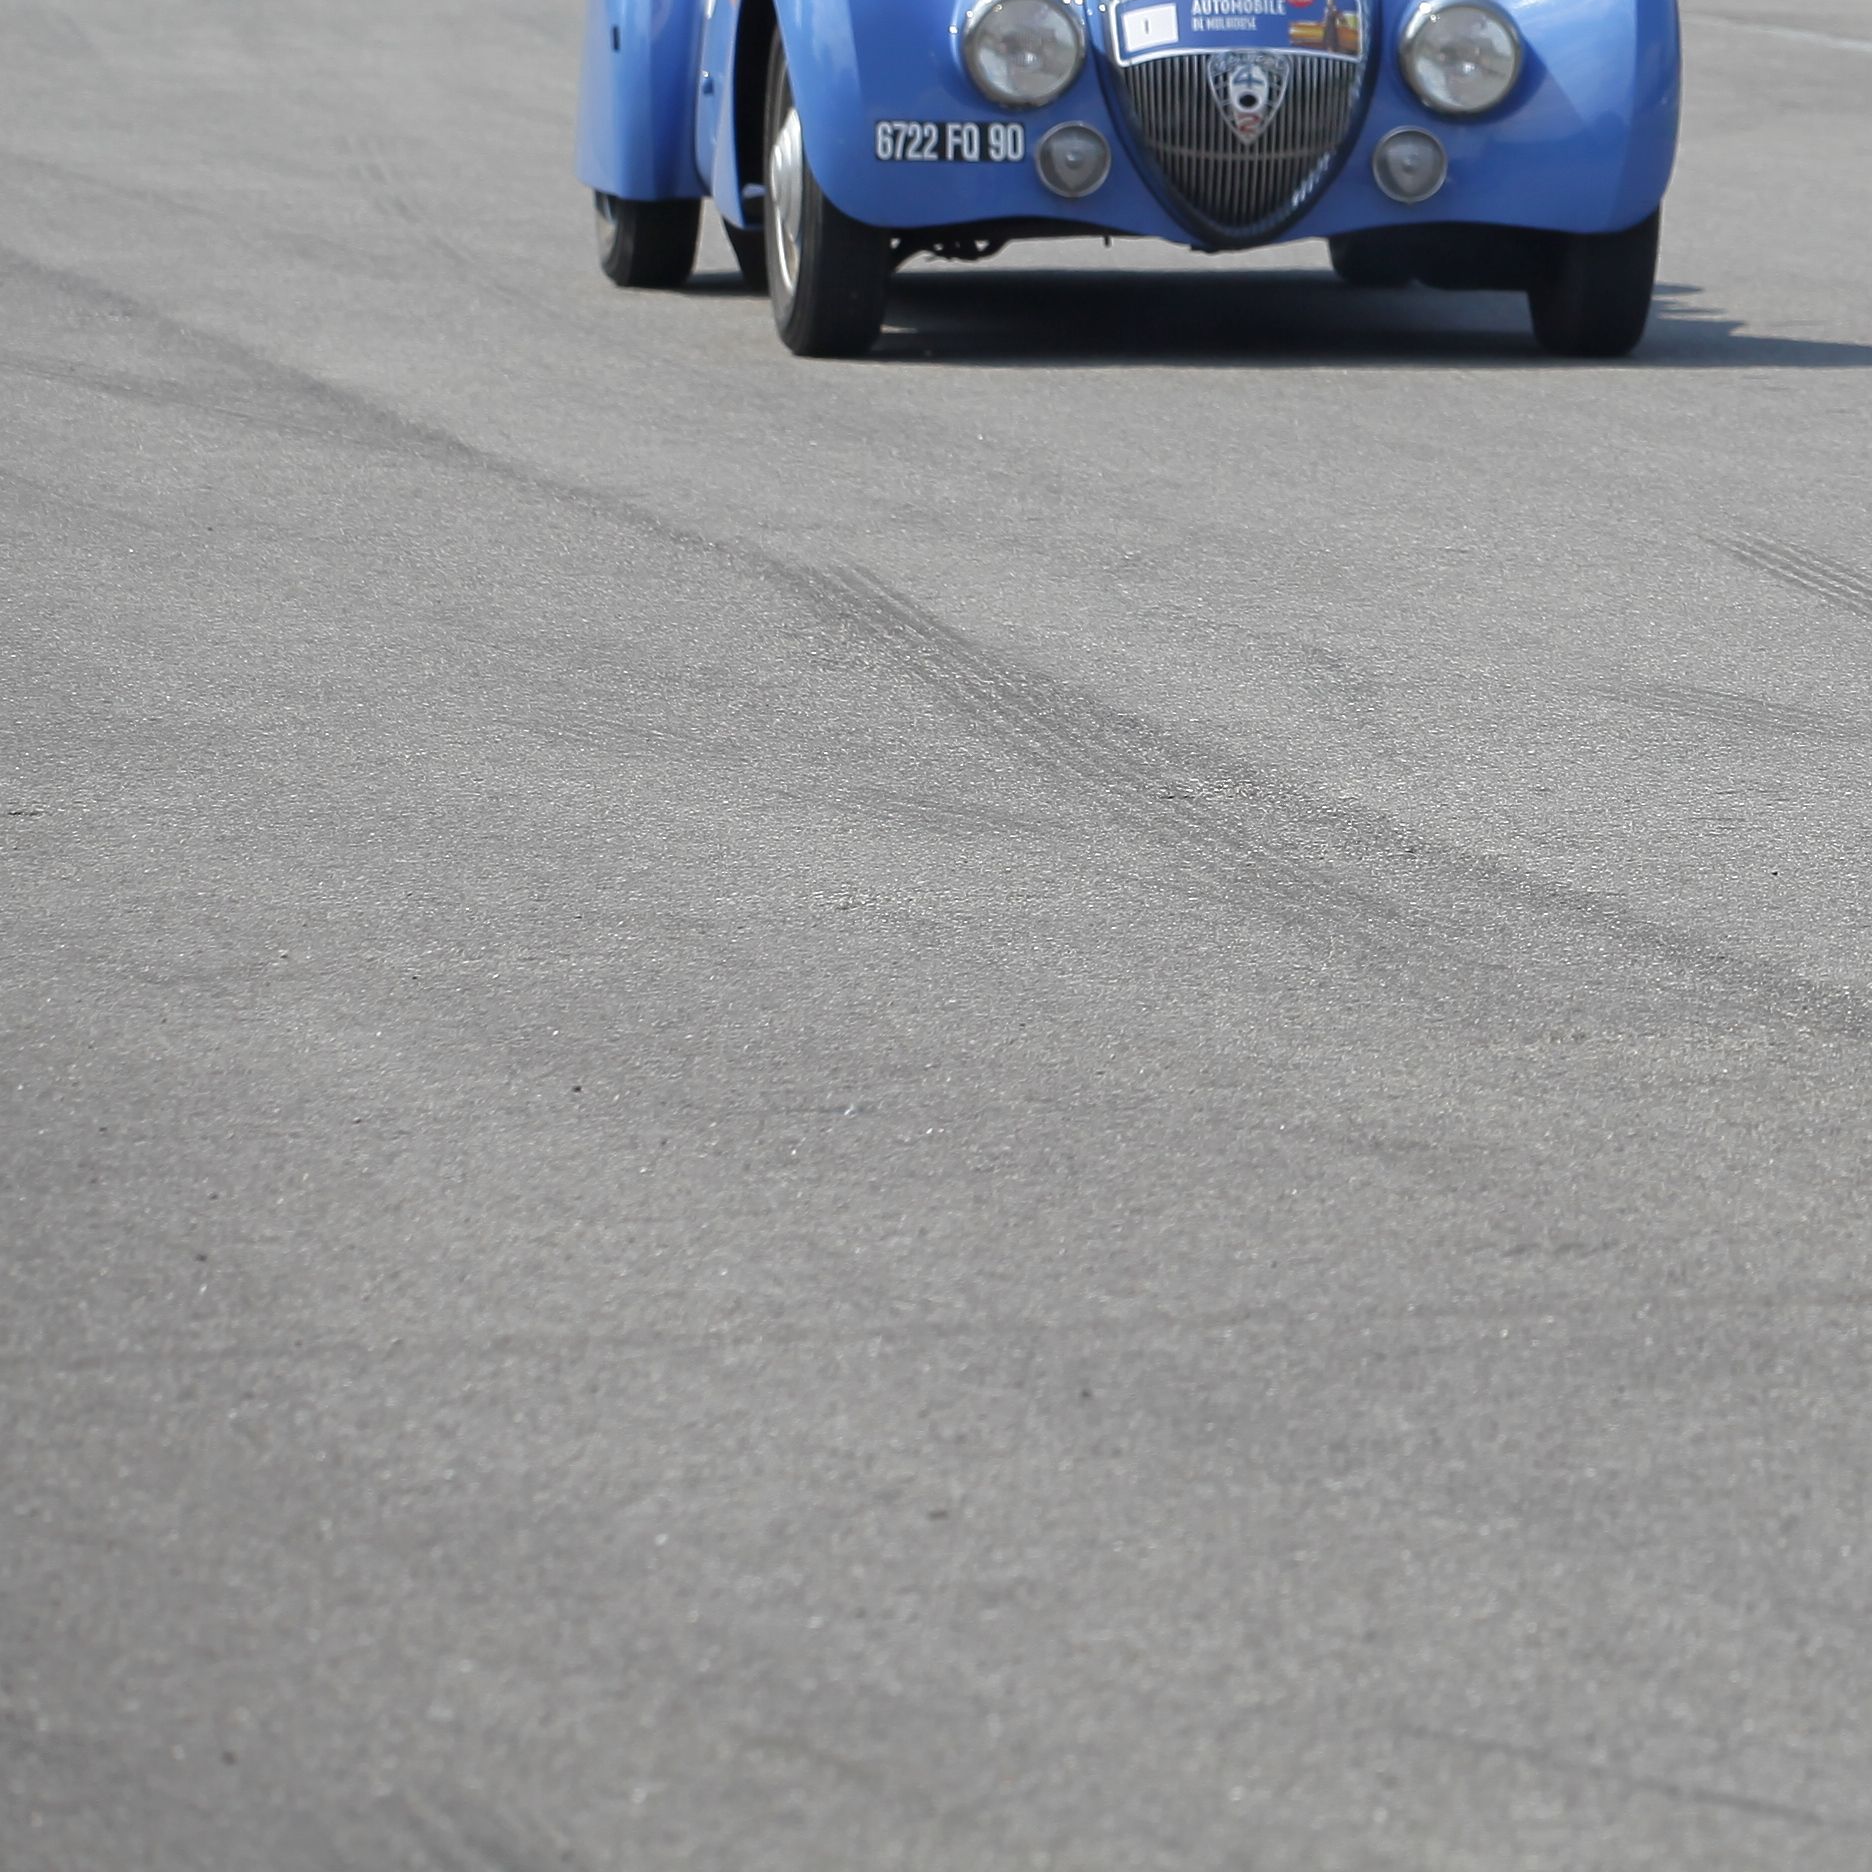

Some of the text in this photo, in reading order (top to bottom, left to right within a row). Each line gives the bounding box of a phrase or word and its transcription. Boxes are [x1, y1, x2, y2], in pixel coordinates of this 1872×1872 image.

[876, 121, 1025, 162] 6722 FQ 90
